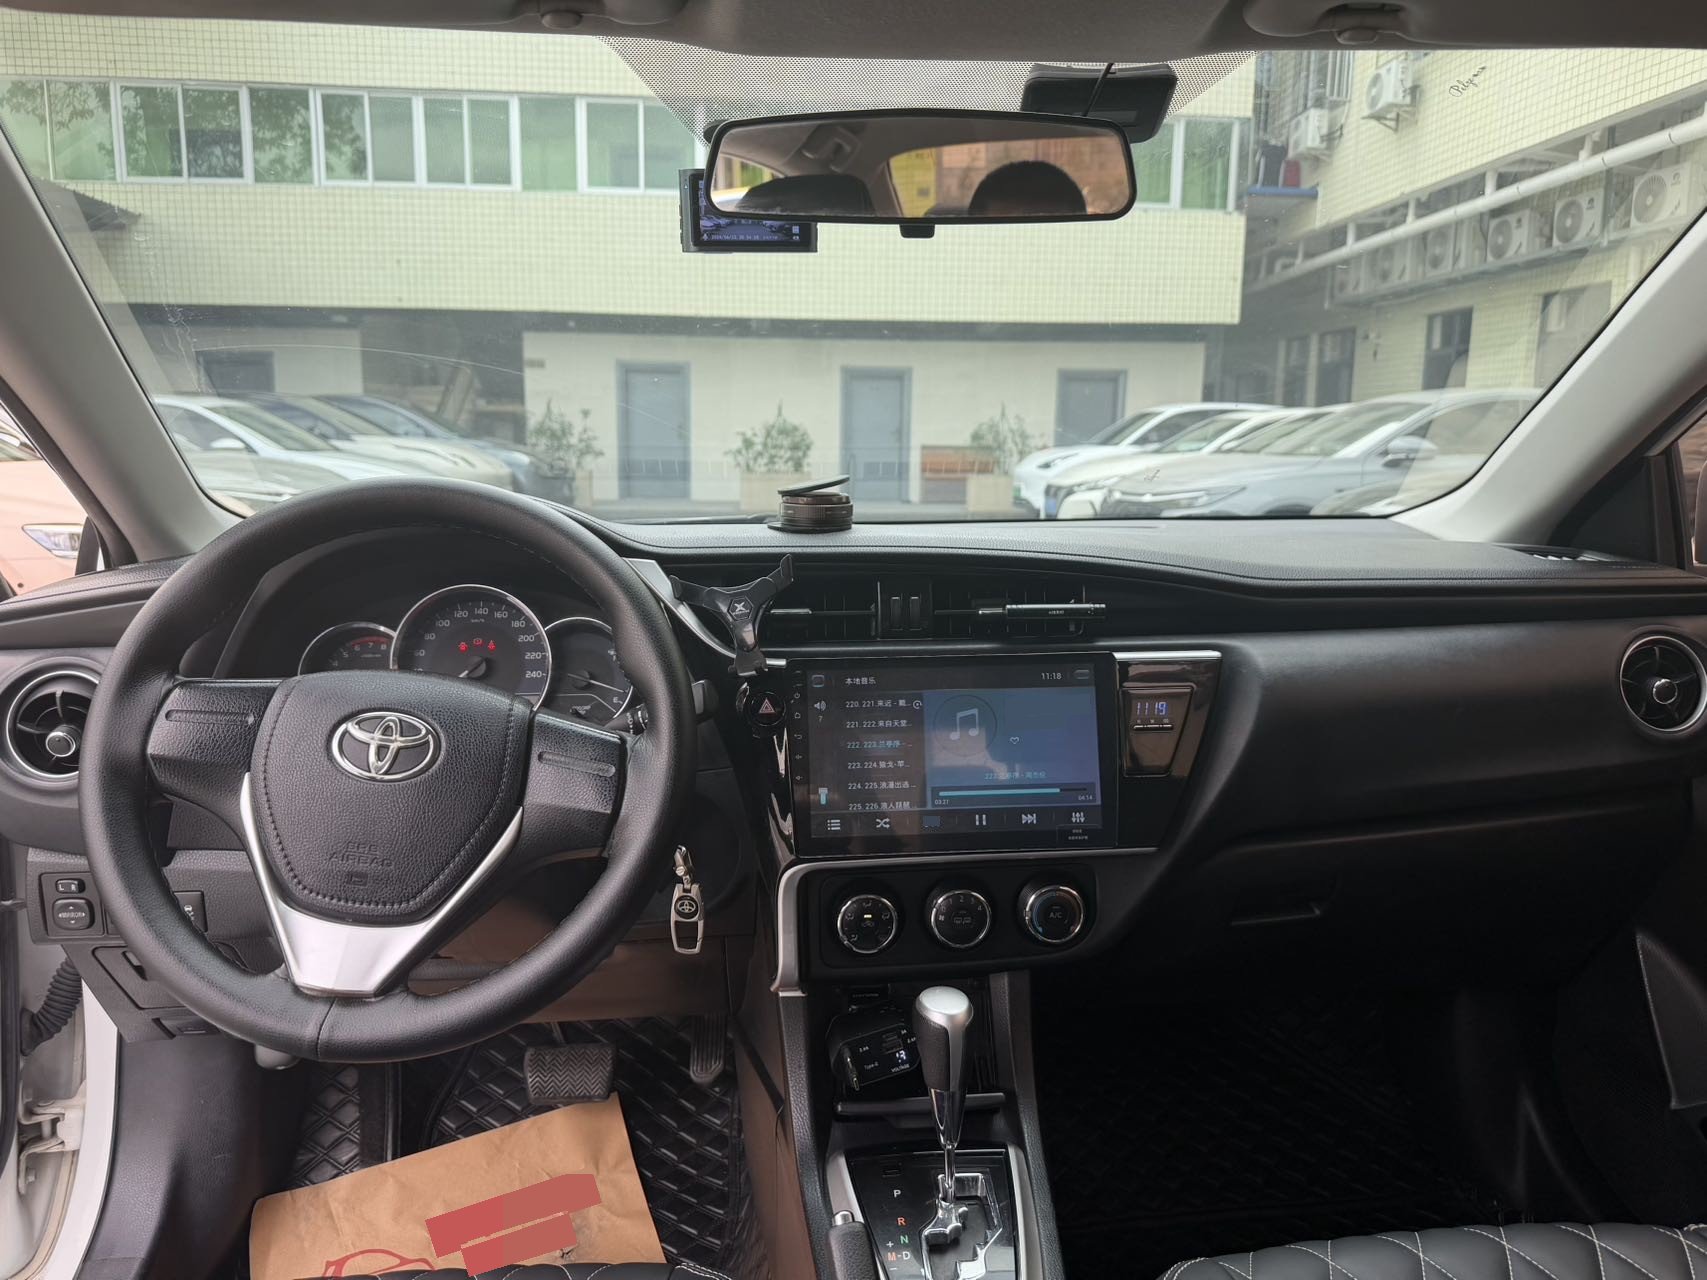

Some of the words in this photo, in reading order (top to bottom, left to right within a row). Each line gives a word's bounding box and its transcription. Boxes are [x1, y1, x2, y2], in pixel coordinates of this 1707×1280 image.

[454, 610, 469, 618] 120
[474, 607, 489, 615] 140
[494, 611, 509, 619] 160
[435, 619, 451, 627] 100
[511, 620, 526, 628] 180
[424, 632, 436, 640] 80
[518, 634, 535, 642] 200
[525, 651, 542, 660] 220
[525, 670, 543, 679] 240
[1041, 672, 1063, 680] 11:18
[845, 676, 877, 685] 本地音乐
[59, 883, 65, 891] L
[71, 883, 77, 891] R
[1049, 911, 1063, 919] A/C
[893, 1189, 901, 1198] P
[897, 1217, 906, 1226] R
[900, 1234, 909, 1244] N
